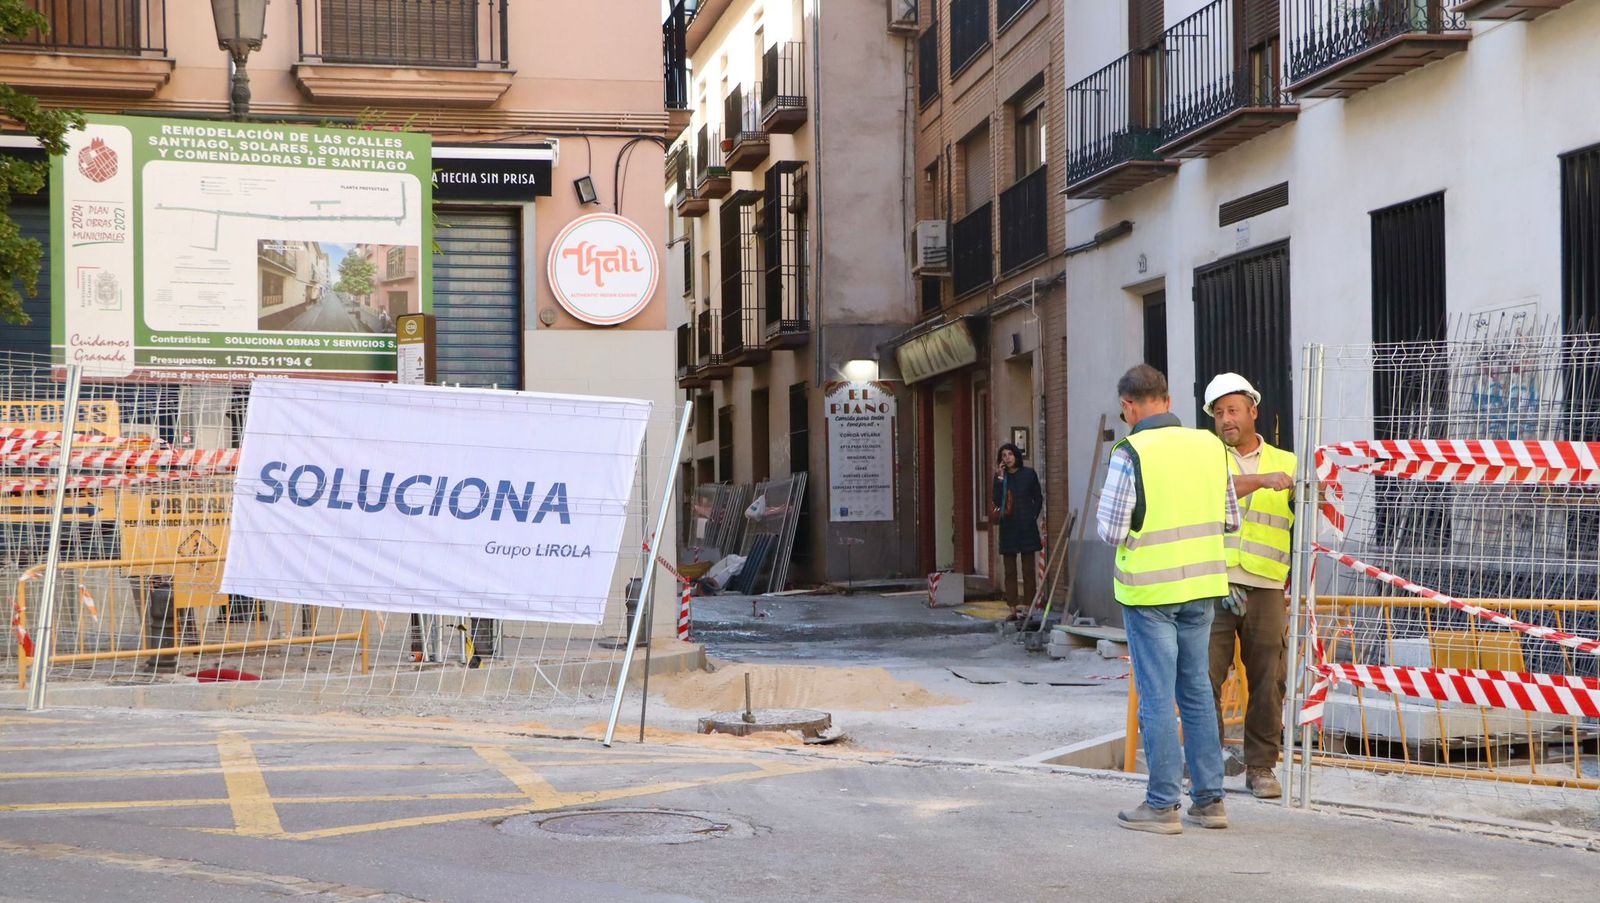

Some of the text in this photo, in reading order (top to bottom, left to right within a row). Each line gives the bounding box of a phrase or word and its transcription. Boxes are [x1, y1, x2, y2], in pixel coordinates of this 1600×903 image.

[162, 125, 403, 148] REMODELACIÓN DE LAS CALLES
[149, 136, 415, 160] SANTIAGO, SOLARES, SOMOSIERRA
[158, 148, 407, 171] Y COMENDADORAS DE SANTIAGO
[441, 172, 477, 184] HECHA
[480, 172, 499, 184] SIN
[503, 173, 536, 185] PRISA
[88, 205, 110, 215] PLAN
[71, 205, 83, 229] 2024
[86, 218, 112, 228] OBRAS
[72, 231, 126, 241] MUNICIPALES
[562, 240, 645, 288] Thali
[70, 333, 130, 347] Cuidamos
[150, 335, 211, 344] Contratista:
[224, 336, 284, 346] SOLUCIONA
[286, 338, 321, 347] OBRAS
[322, 339, 331, 347] Y
[332, 339, 385, 348] SERVICIOS
[74, 348, 127, 361] Granada
[150, 355, 313, 367] Presupuesto: 1.570.511'94 €
[150, 370, 178, 379] Plazo
[179, 371, 193, 379] de
[849, 389, 872, 400] EL
[830, 402, 890, 414] PIANO
[255, 460, 572, 525] SOLUCIONA
[484, 541, 592, 560] Grupo LIROLA
